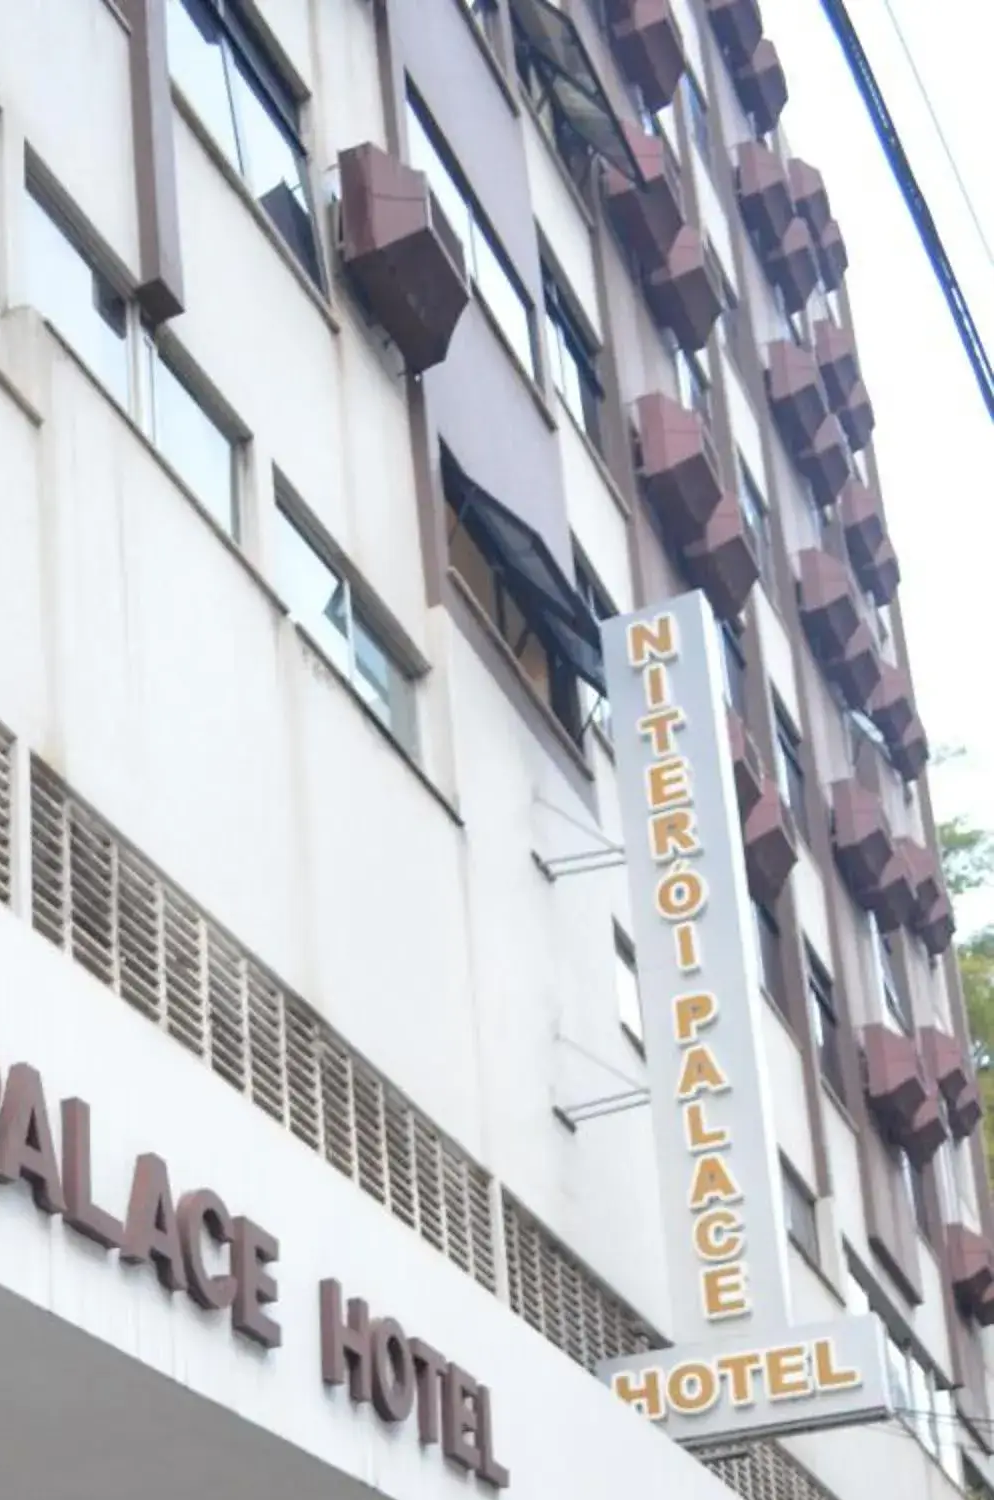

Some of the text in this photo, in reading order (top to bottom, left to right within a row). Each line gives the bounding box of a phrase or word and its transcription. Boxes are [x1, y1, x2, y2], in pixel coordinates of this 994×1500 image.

[673, 993, 751, 1319] PALACE
[319, 1277, 509, 1489] HOTEL
[612, 1337, 862, 1421] HOTEL
